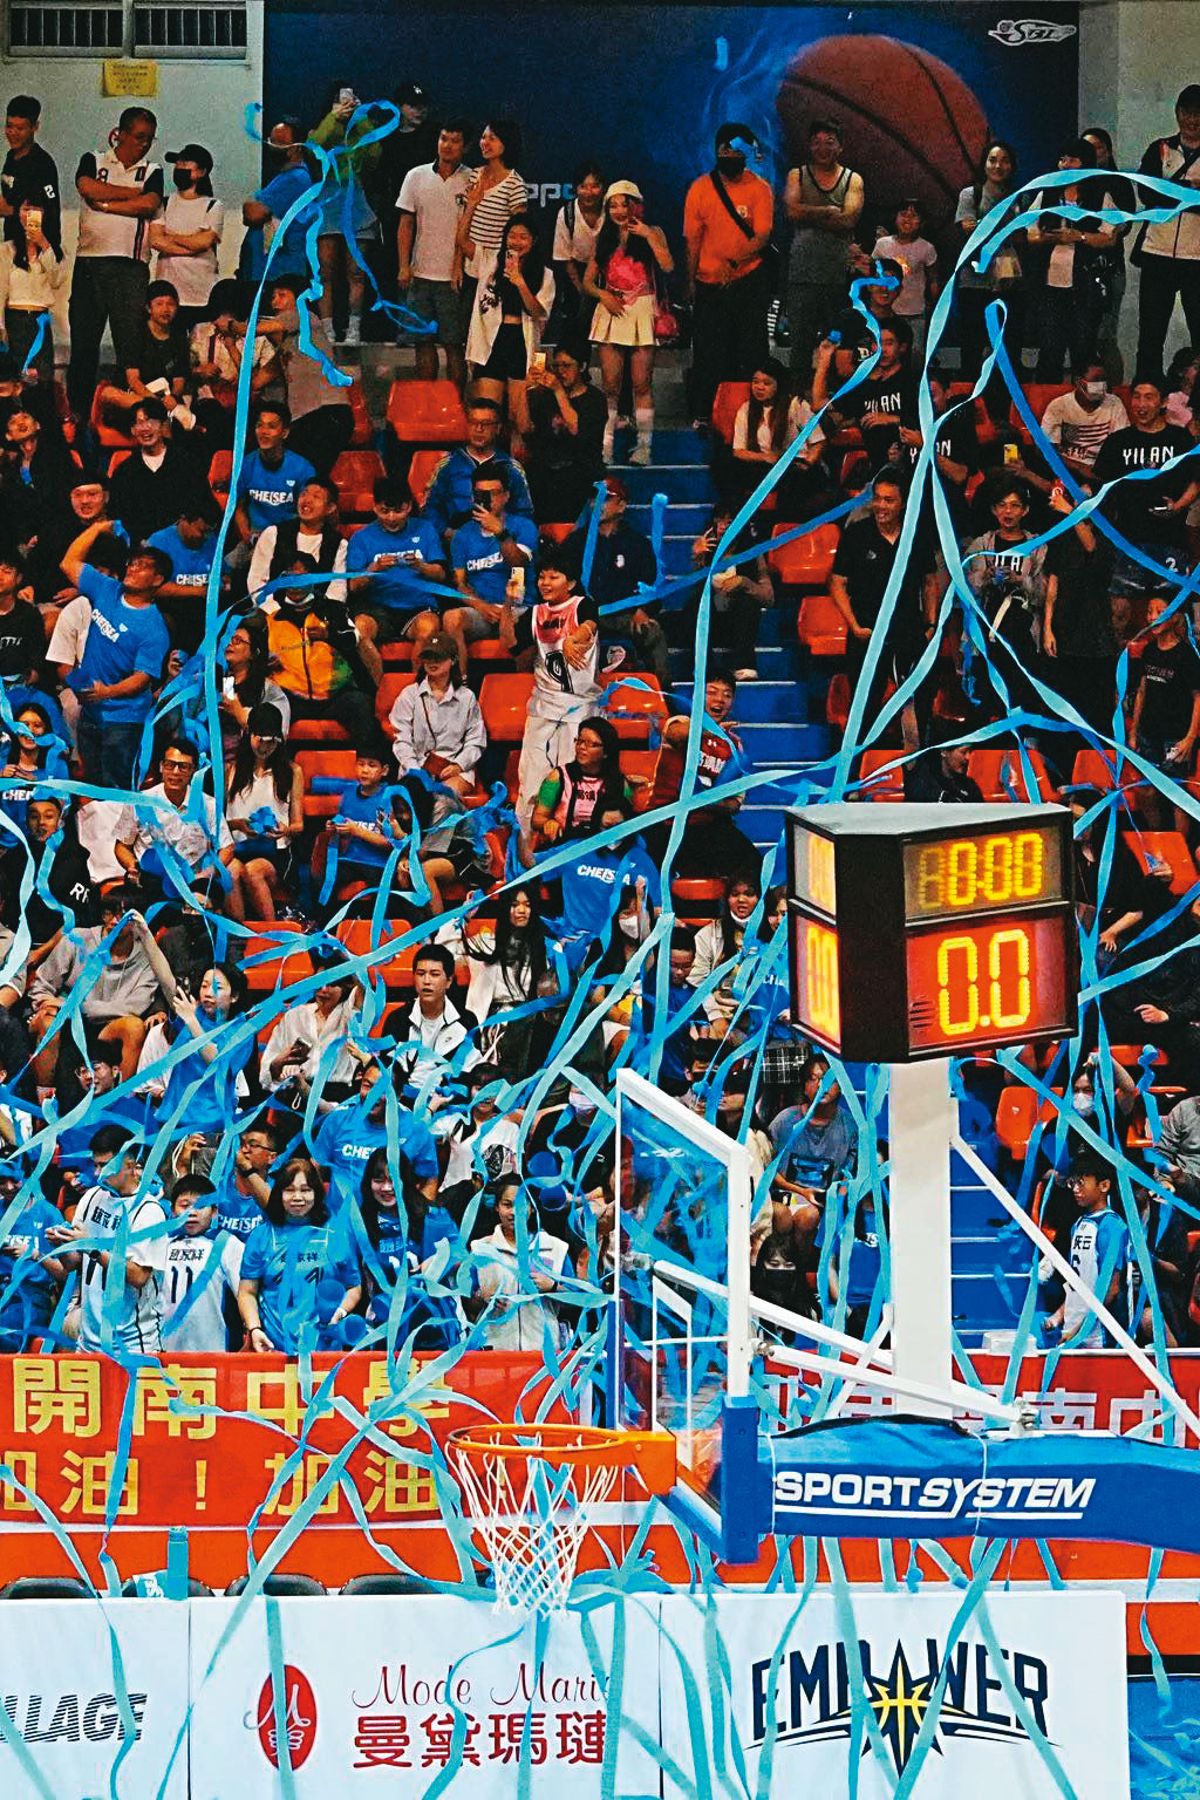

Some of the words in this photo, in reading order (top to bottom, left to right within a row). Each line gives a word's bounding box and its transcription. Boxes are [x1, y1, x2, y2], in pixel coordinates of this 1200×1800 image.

[938, 929, 1030, 1036] 0.0
[12, 1358, 451, 1439] 開南中學
[352, 1663, 472, 1709] Mode
